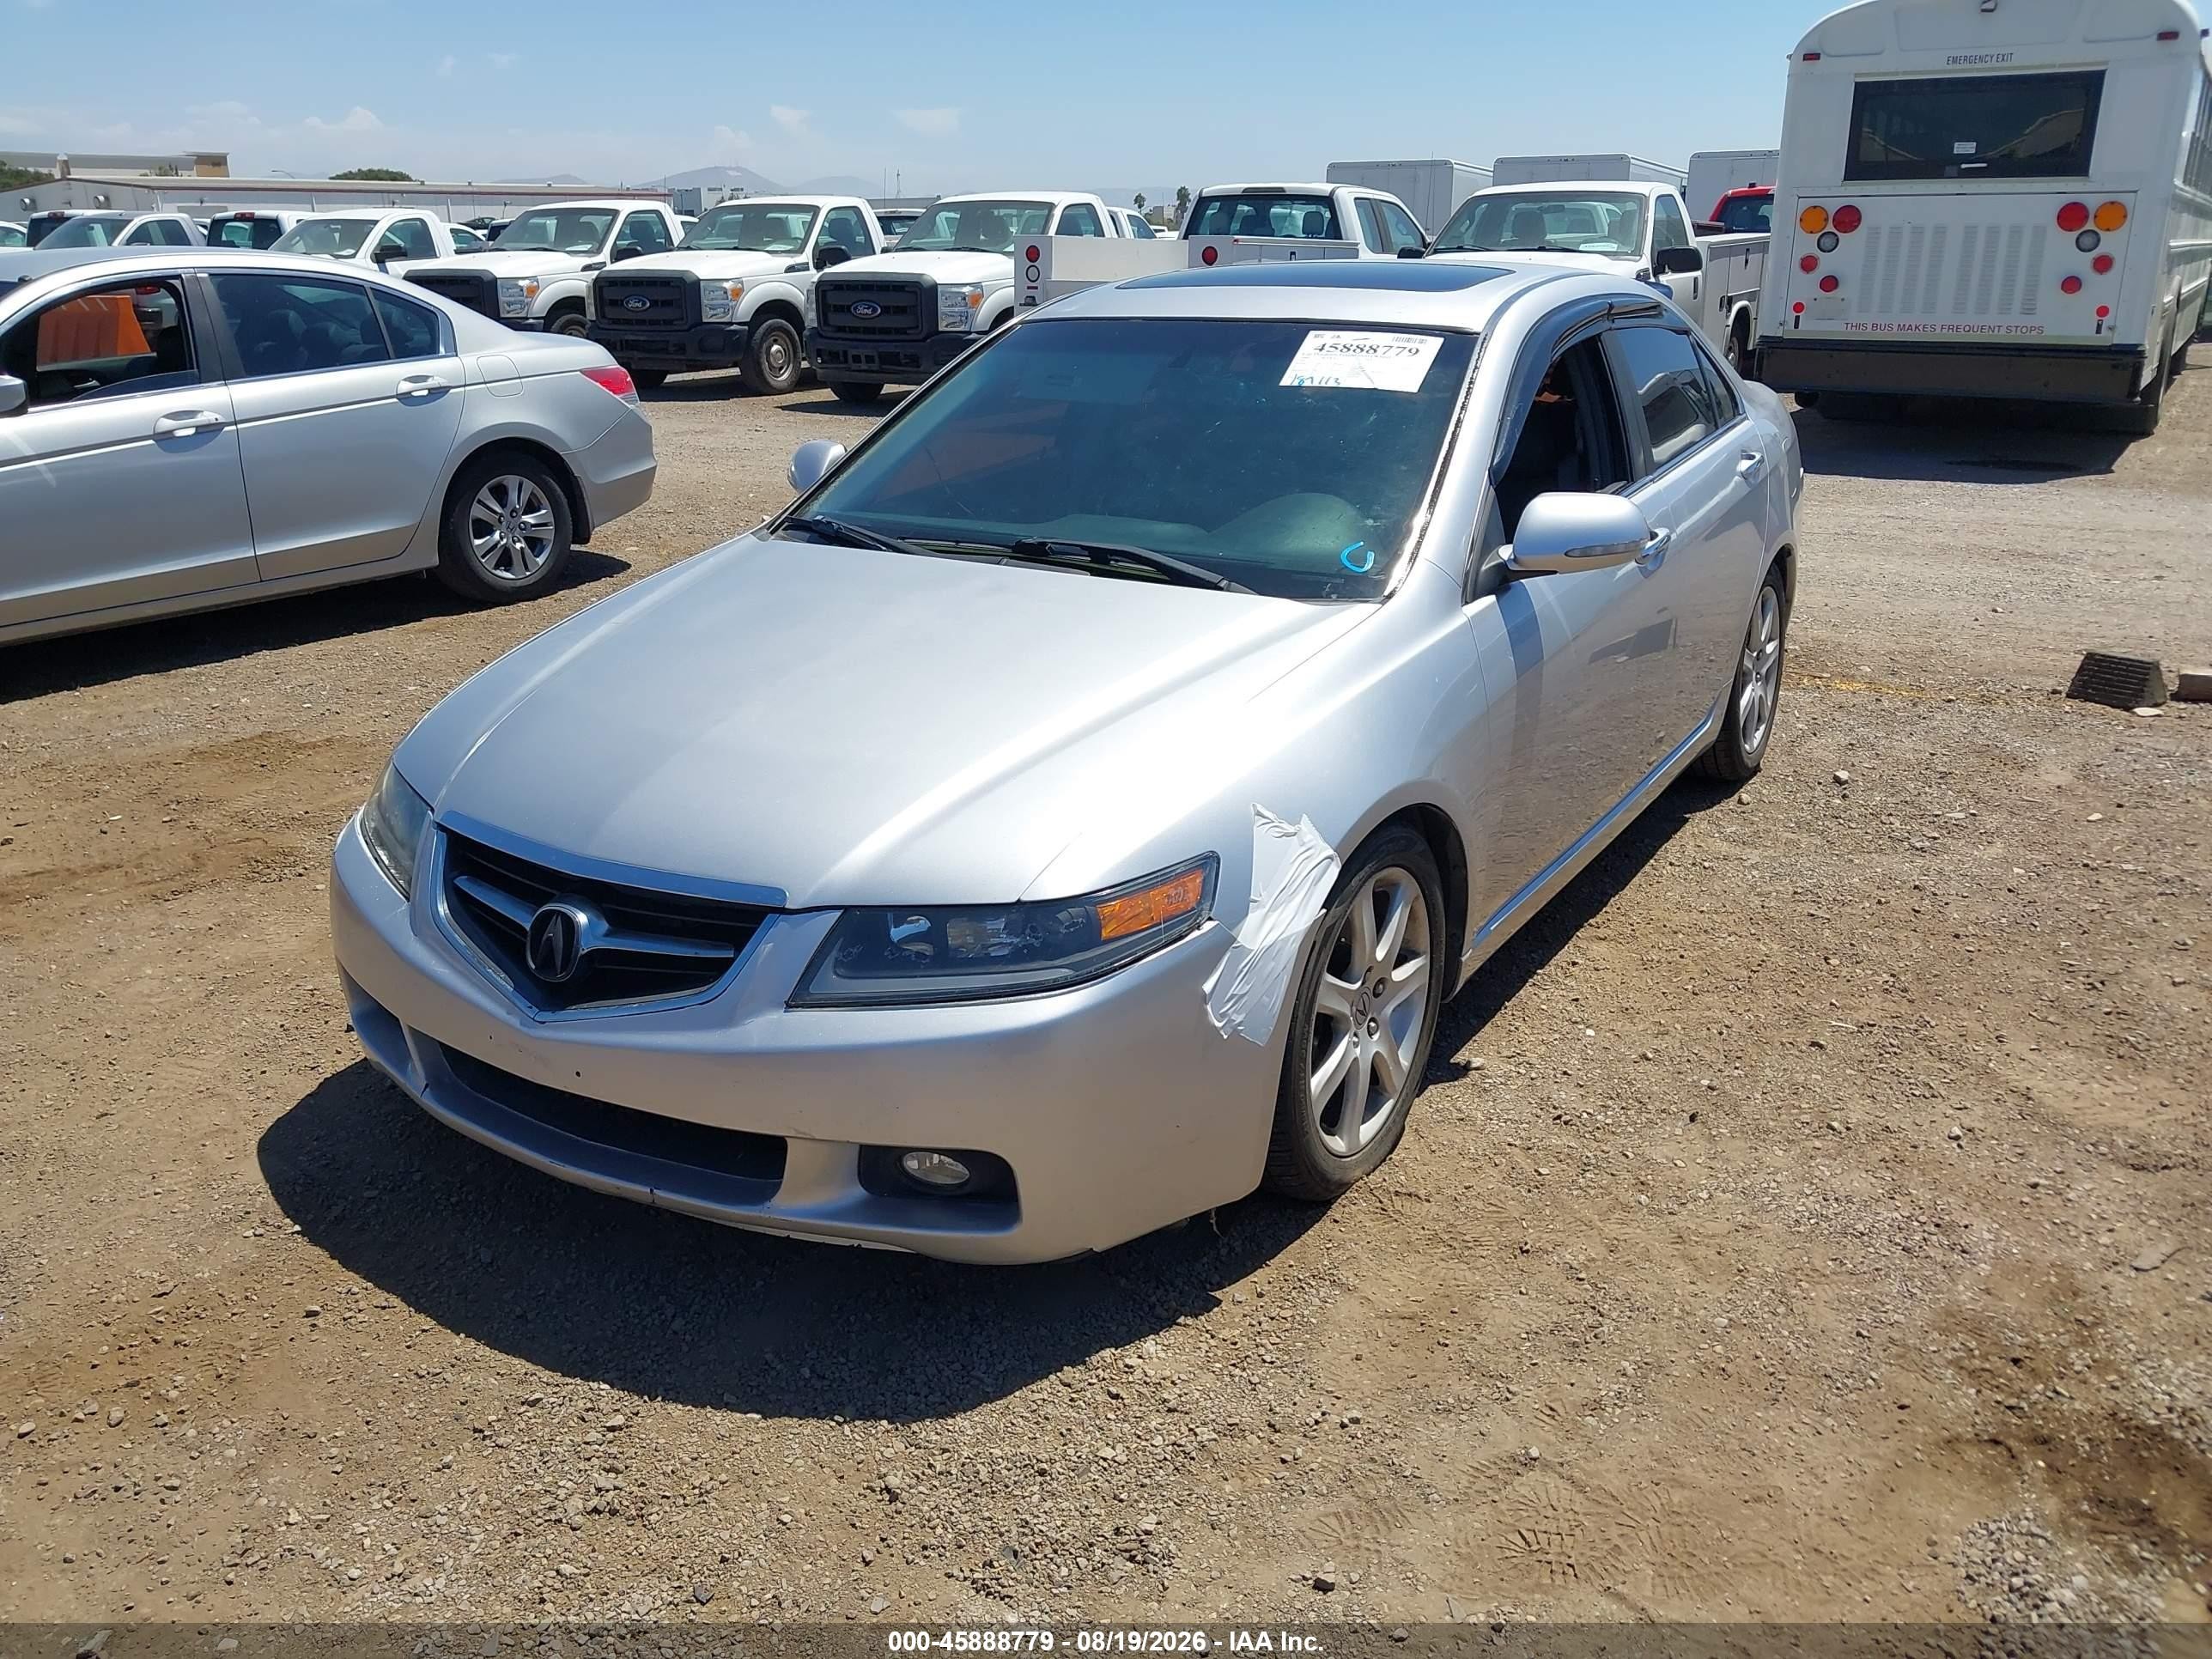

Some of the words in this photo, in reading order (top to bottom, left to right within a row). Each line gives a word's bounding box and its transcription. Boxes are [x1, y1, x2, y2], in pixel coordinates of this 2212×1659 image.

[1946, 53, 1995, 65] EMERGENCY
[1996, 52, 2014, 63] EXIT
[1844, 322, 1869, 331] THIS
[1871, 322, 1894, 332] BUS
[1896, 323, 1937, 333] MAKES
[1940, 324, 2003, 334] FREQUENT
[2005, 325, 2045, 335] STOPS
[1313, 343, 1420, 357] 45888779
